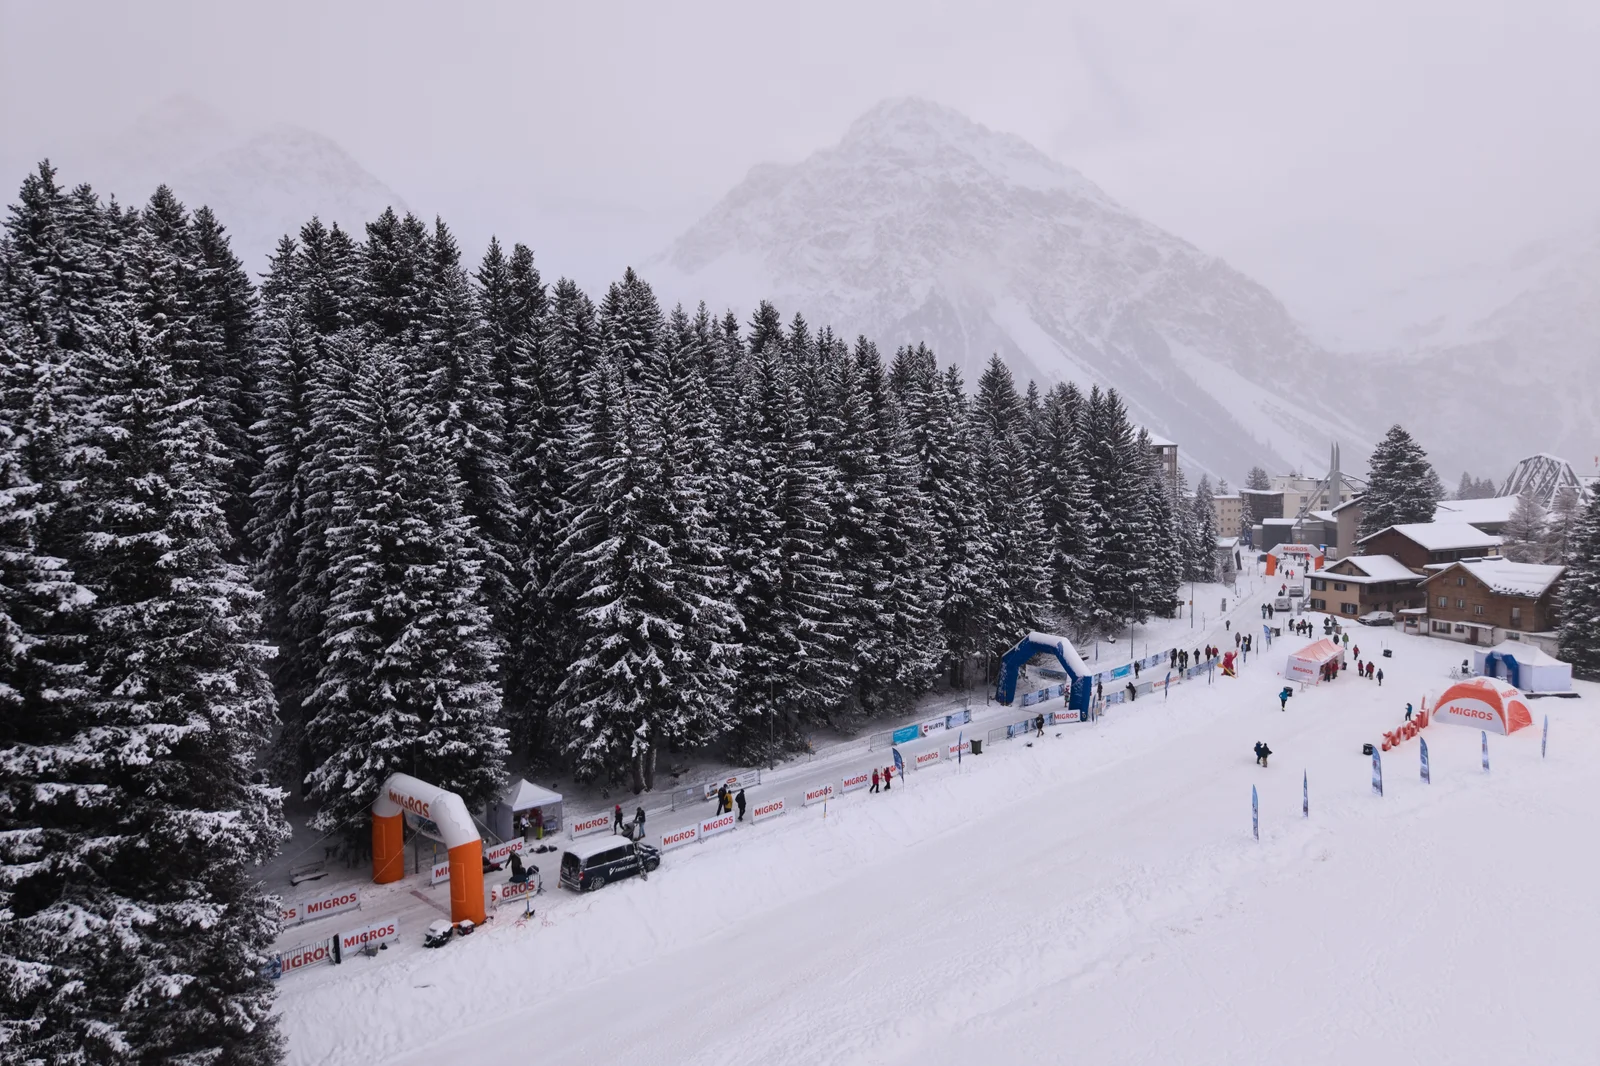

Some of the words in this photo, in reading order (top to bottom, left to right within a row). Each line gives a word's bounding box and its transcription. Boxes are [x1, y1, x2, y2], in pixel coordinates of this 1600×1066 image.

[1292, 665, 1314, 675] MIGROS
[1054, 712, 1079, 720] MIGROS
[1449, 705, 1493, 721] MIGROS
[917, 751, 939, 763] MIGROS
[844, 774, 868, 788] MIGROS
[806, 786, 832, 801] MIGROS
[389, 788, 430, 819] MIGROS
[754, 801, 783, 817] MIGROS
[574, 816, 609, 833] MIGROS
[703, 816, 734, 832] MIGROS
[663, 829, 696, 846] MIGROS
[488, 841, 523, 860] MIGROS
[307, 892, 357, 914] MIGROS
[343, 924, 395, 949] MIGROS
